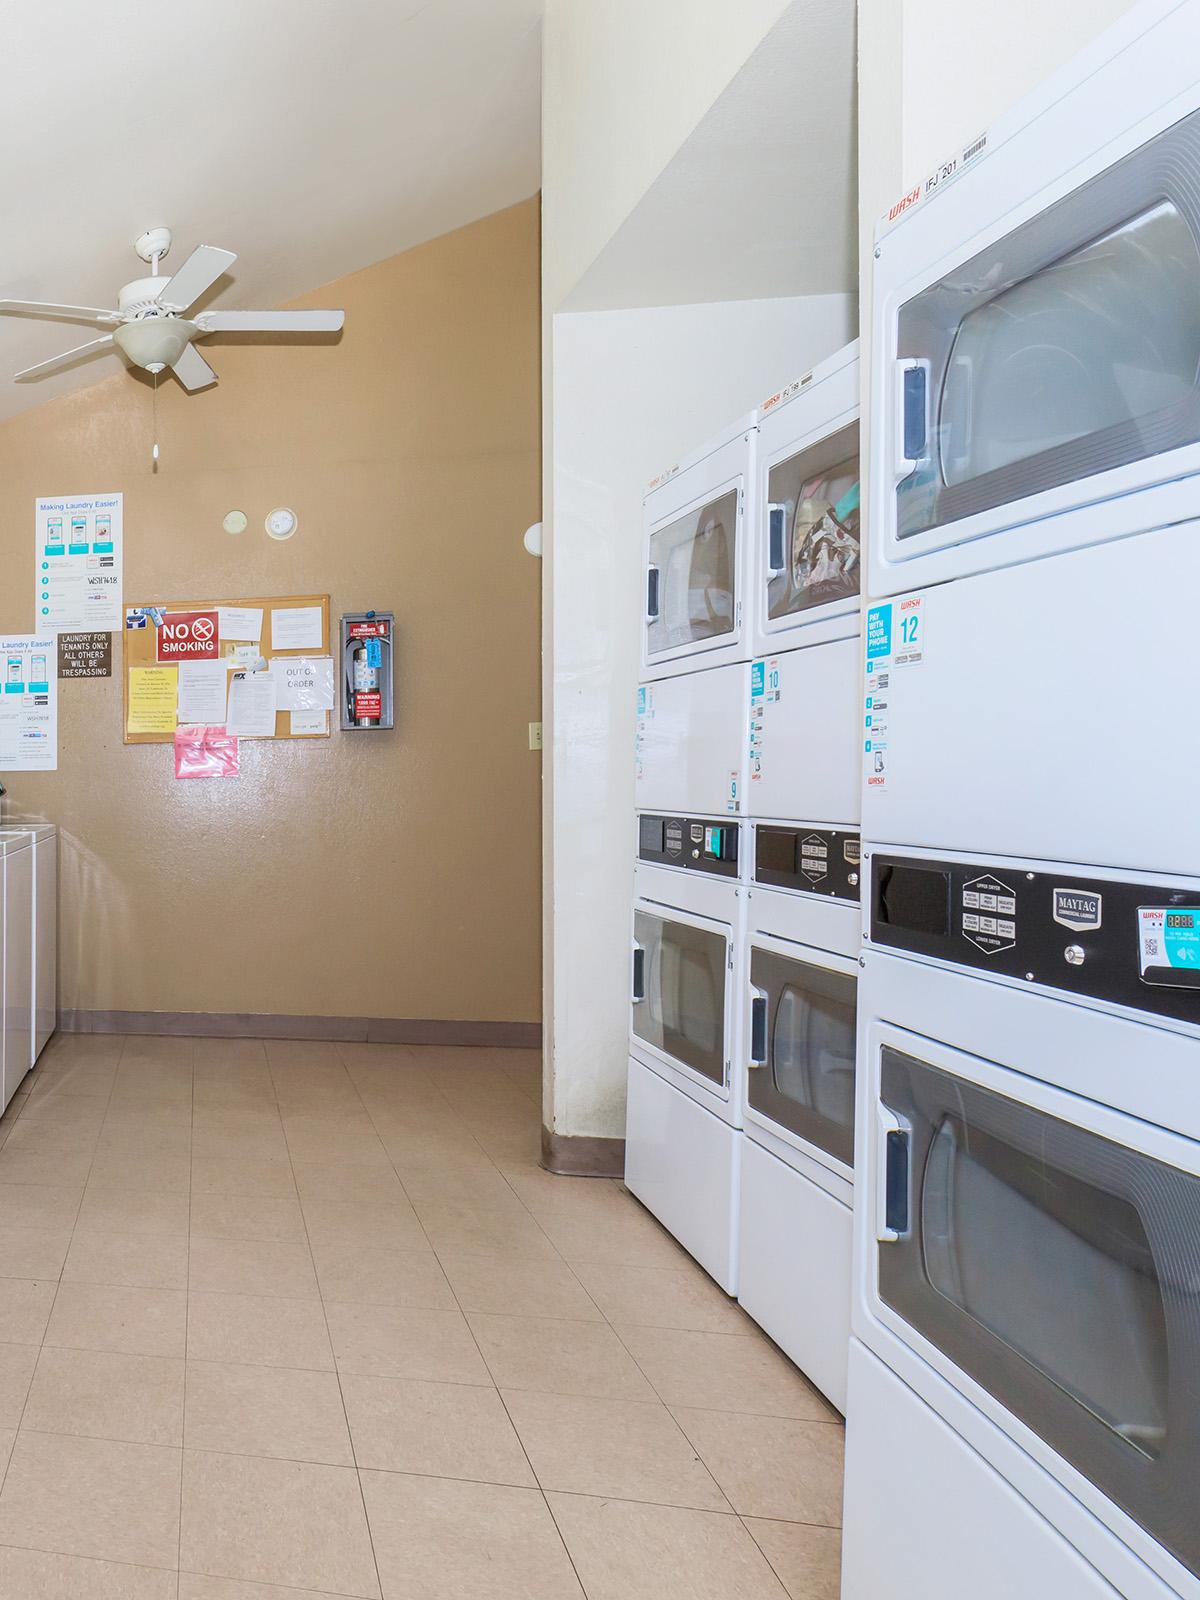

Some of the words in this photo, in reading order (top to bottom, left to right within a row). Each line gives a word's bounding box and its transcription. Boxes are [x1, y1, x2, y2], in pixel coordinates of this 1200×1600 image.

[889, 186, 921, 221] WASH
[925, 173, 939, 193] IFJ
[942, 160, 957, 179] 201
[40, 503, 64, 511] Making
[66, 501, 93, 509] Laundry
[95, 499, 119, 508] Easier!
[901, 599, 920, 610] WASH
[869, 612, 880, 622] PAY
[869, 619, 884, 630] WITH
[901, 616, 918, 643] 12
[162, 623, 189, 640] NO
[869, 628, 884, 638] YOUR
[62, 634, 91, 642] LAUNDRY
[94, 633, 106, 641] FOR
[869, 635, 888, 647] PHONE
[31, 640, 53, 648] Easier!
[61, 643, 90, 651] TENANTS
[162, 641, 214, 652] SMOKING
[89, 659, 97, 667] BE
[62, 668, 107, 676] TRESPASSING
[769, 671, 778, 688] 10
[732, 782, 736, 798] 9
[1059, 896, 1096, 912] MAYTAG
